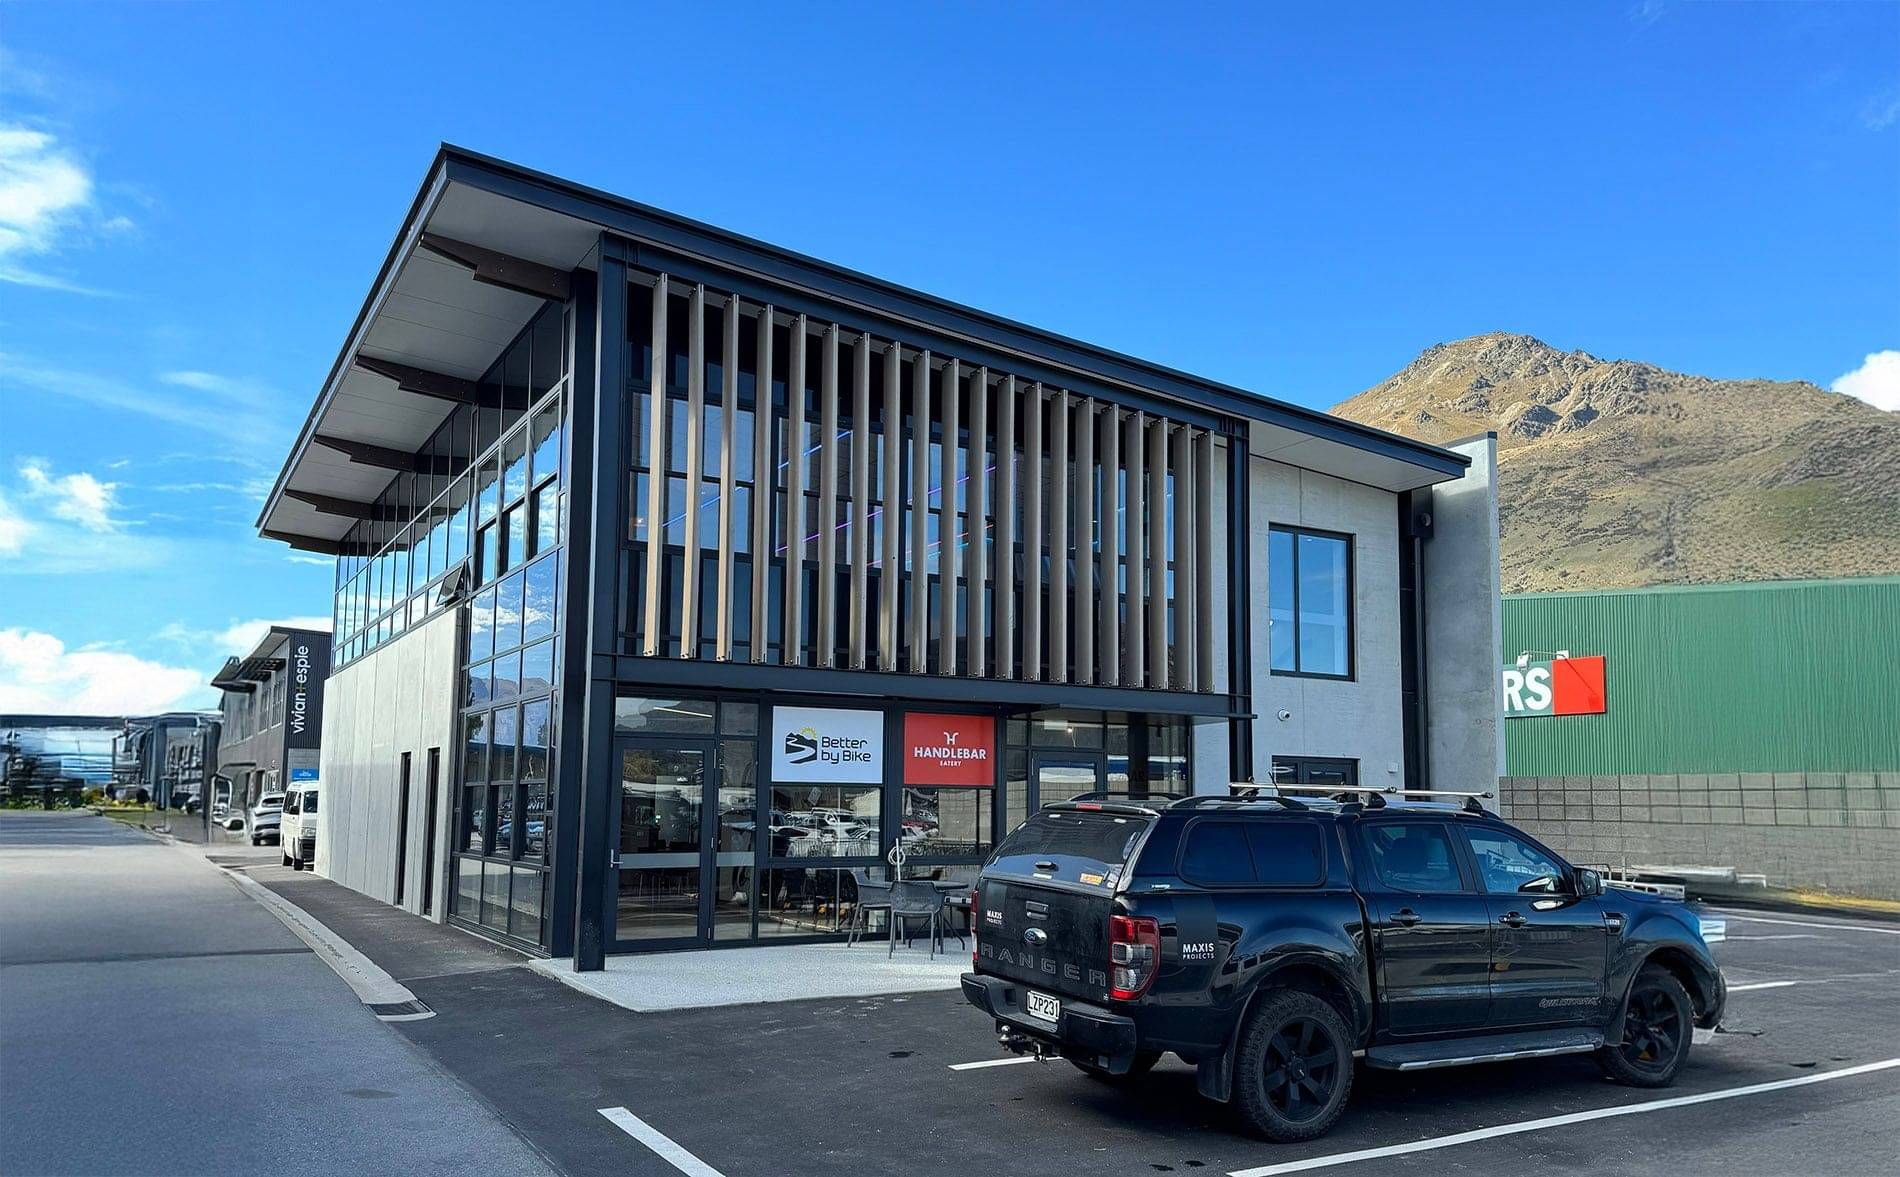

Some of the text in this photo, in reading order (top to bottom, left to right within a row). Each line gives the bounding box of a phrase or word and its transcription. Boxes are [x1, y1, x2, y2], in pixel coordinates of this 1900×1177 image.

[821, 736, 868, 749] Better
[821, 750, 871, 764] by Bike
[914, 746, 986, 760] HANDLEBAR
[986, 909, 1002, 919] MAXIS
[1182, 942, 1215, 953] MAXIS
[1182, 952, 1215, 960] PROJECTS
[980, 942, 1106, 987] RANGER
[1027, 992, 1060, 1018] LZP231
